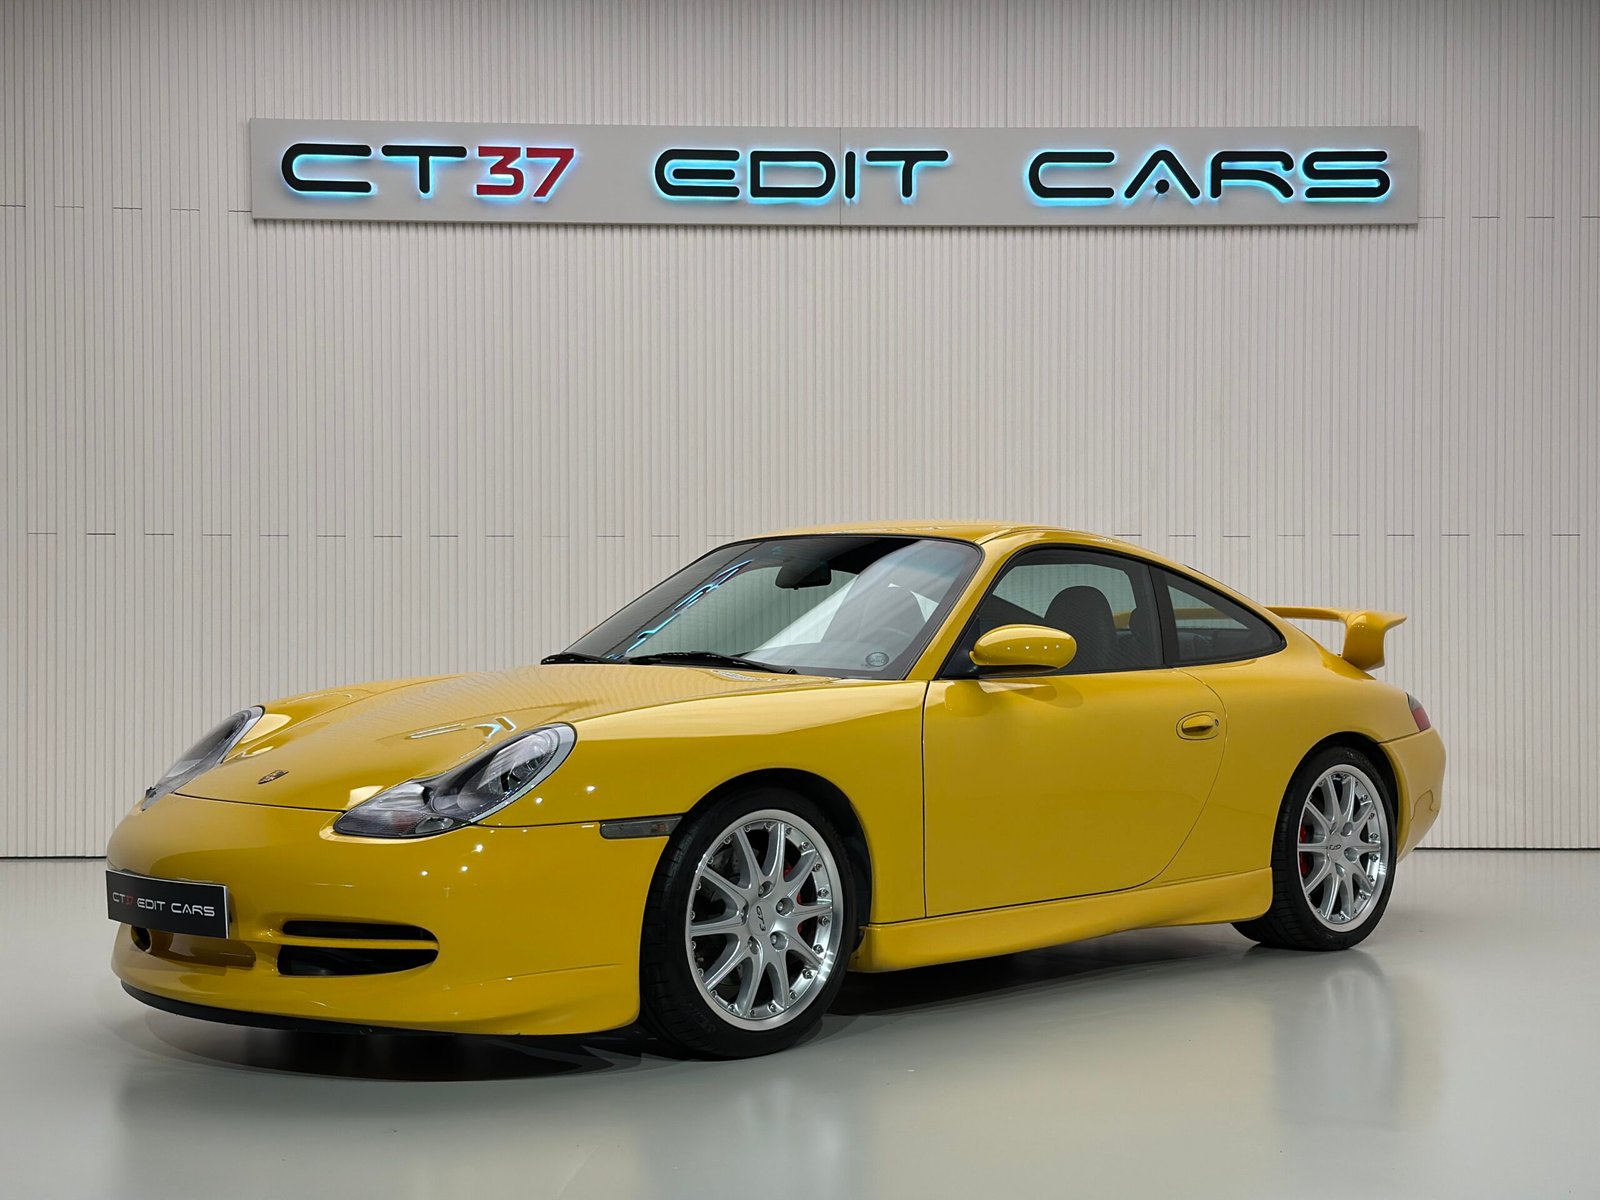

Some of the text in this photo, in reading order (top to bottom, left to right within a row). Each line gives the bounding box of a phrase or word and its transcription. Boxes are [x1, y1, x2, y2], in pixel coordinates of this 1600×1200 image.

[281, 142, 1391, 200] CT37 EDIT CARS
[112, 891, 216, 917] CT37 EDIT CARS
[756, 905, 766, 932] GT3
